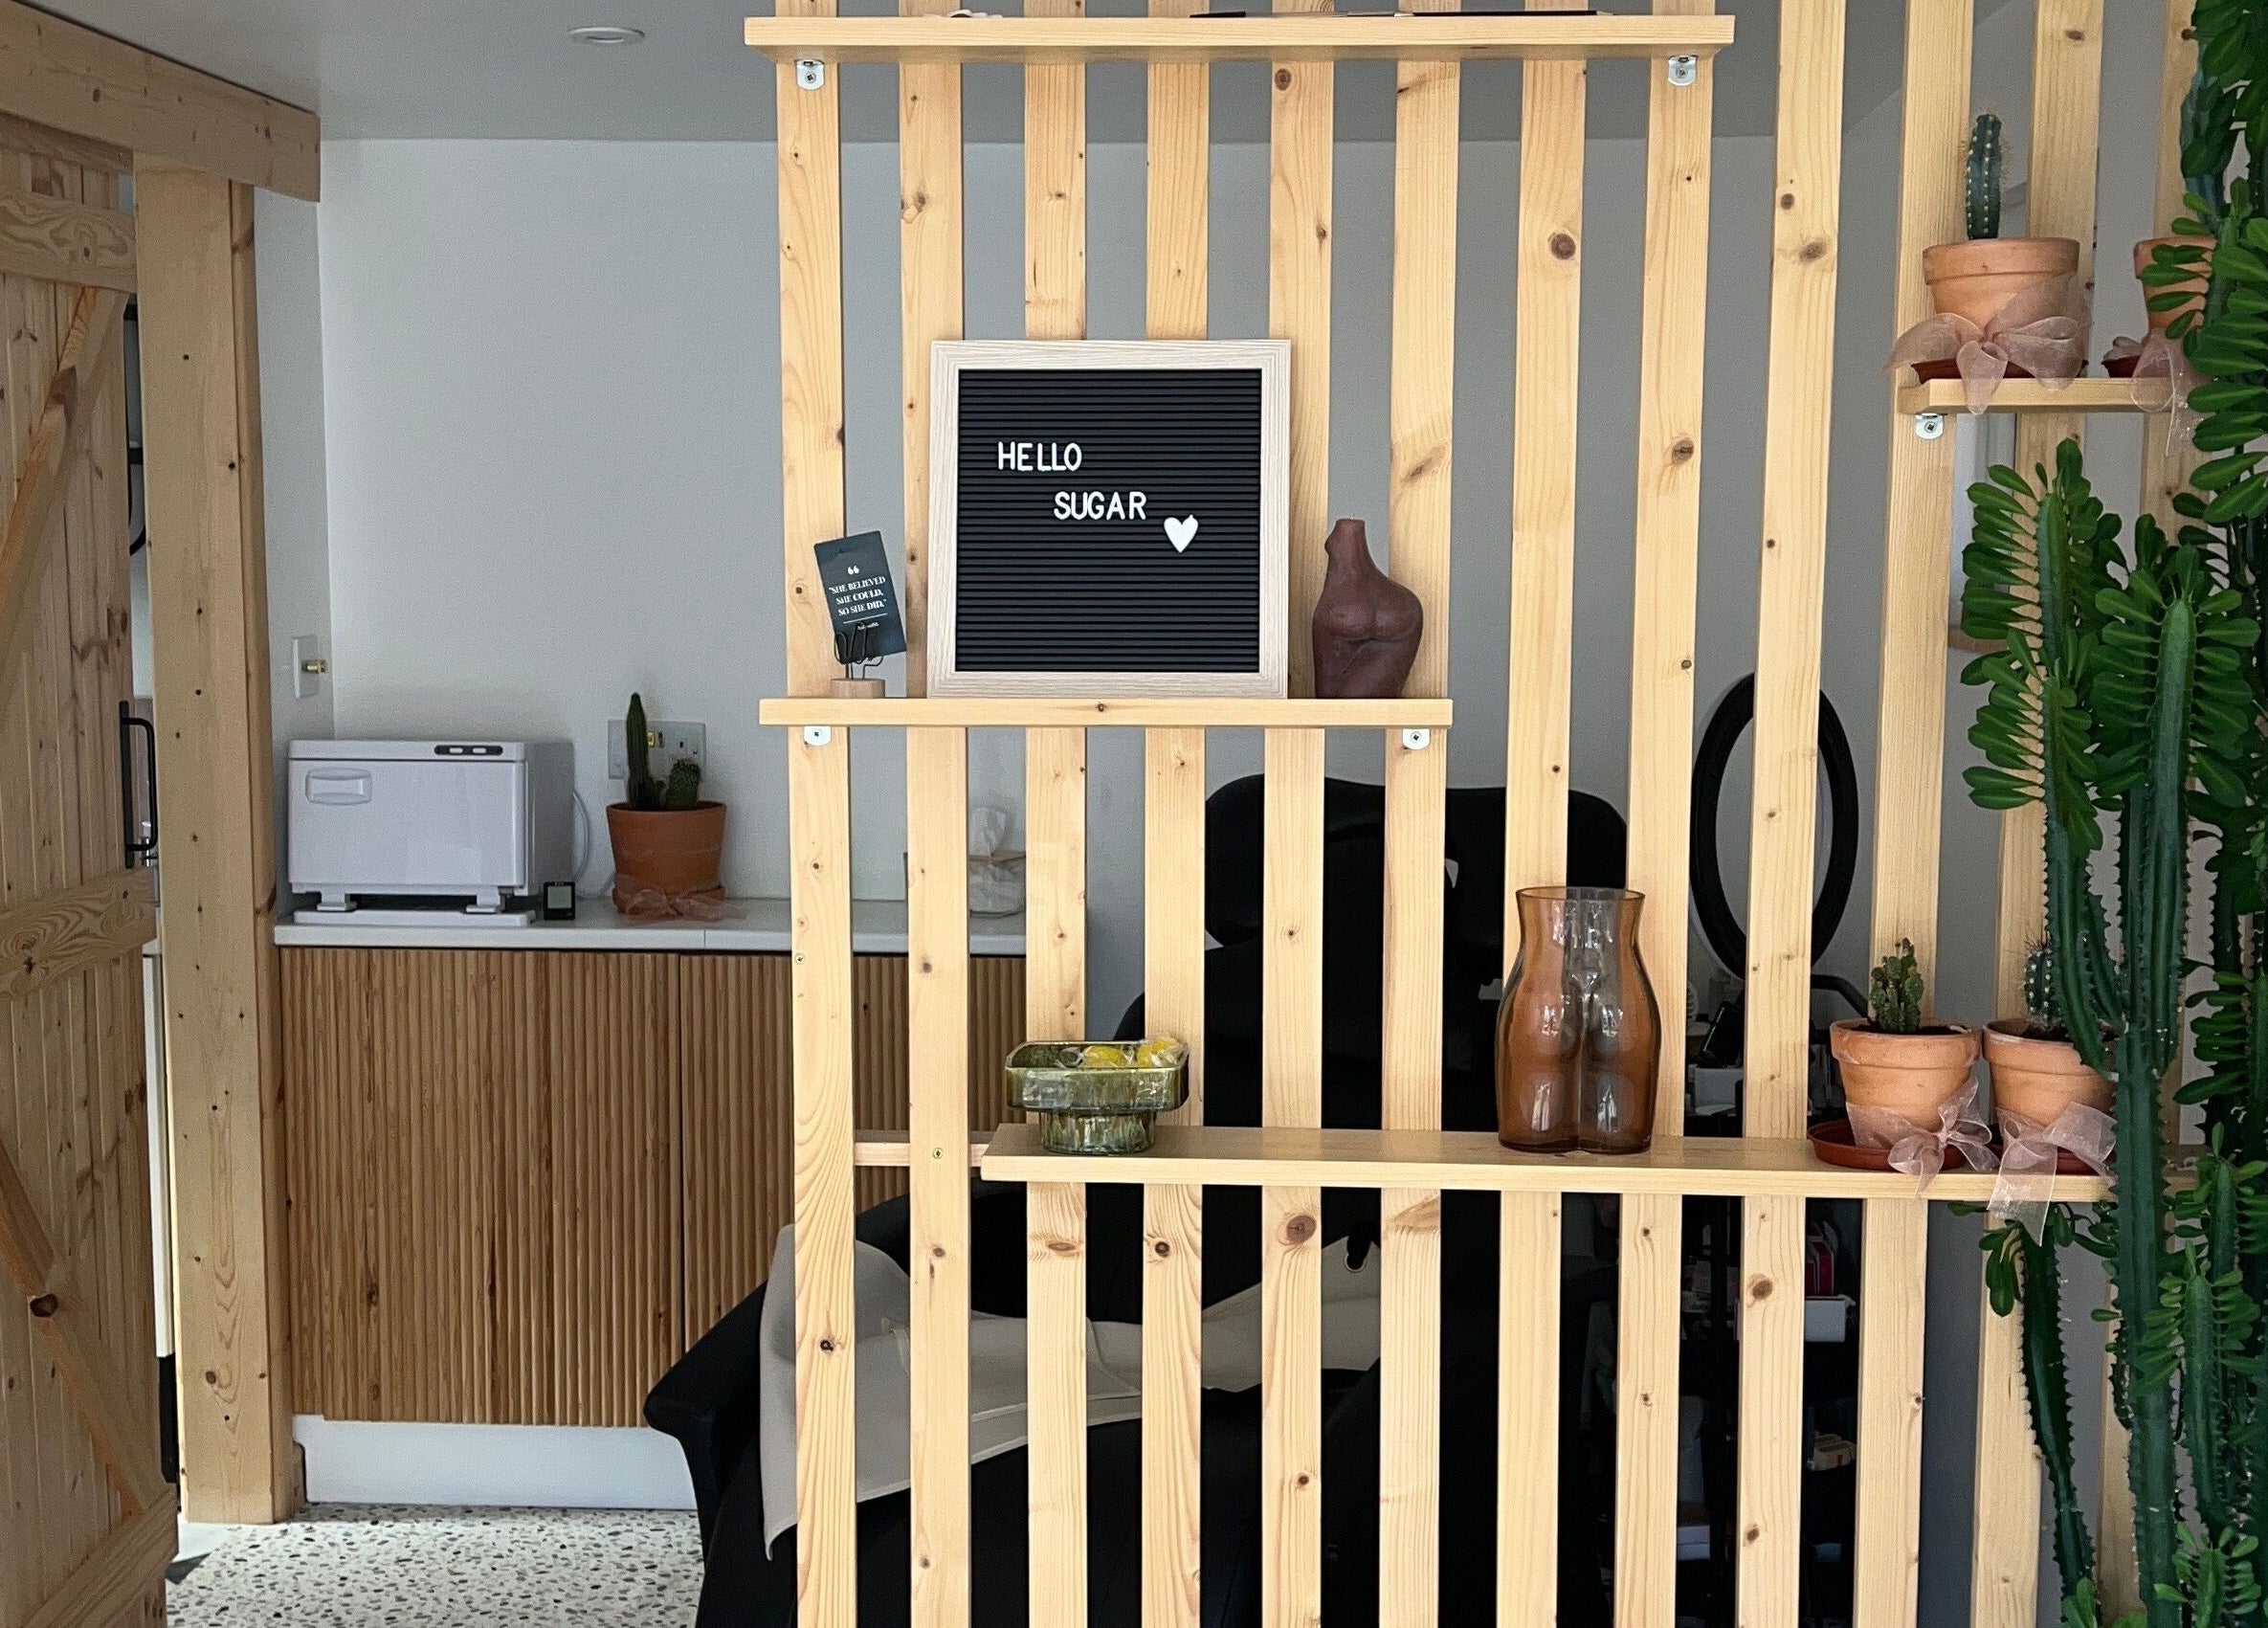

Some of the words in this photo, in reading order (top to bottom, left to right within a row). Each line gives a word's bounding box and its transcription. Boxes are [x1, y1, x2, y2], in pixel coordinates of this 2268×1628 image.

[997, 440, 1083, 472] HELLO
[1053, 491, 1147, 521] SUGAR
[847, 576, 886, 591] BELIEVED
[835, 594, 852, 605] SHE
[837, 607, 850, 616] SO
[850, 603, 867, 613] SHE
